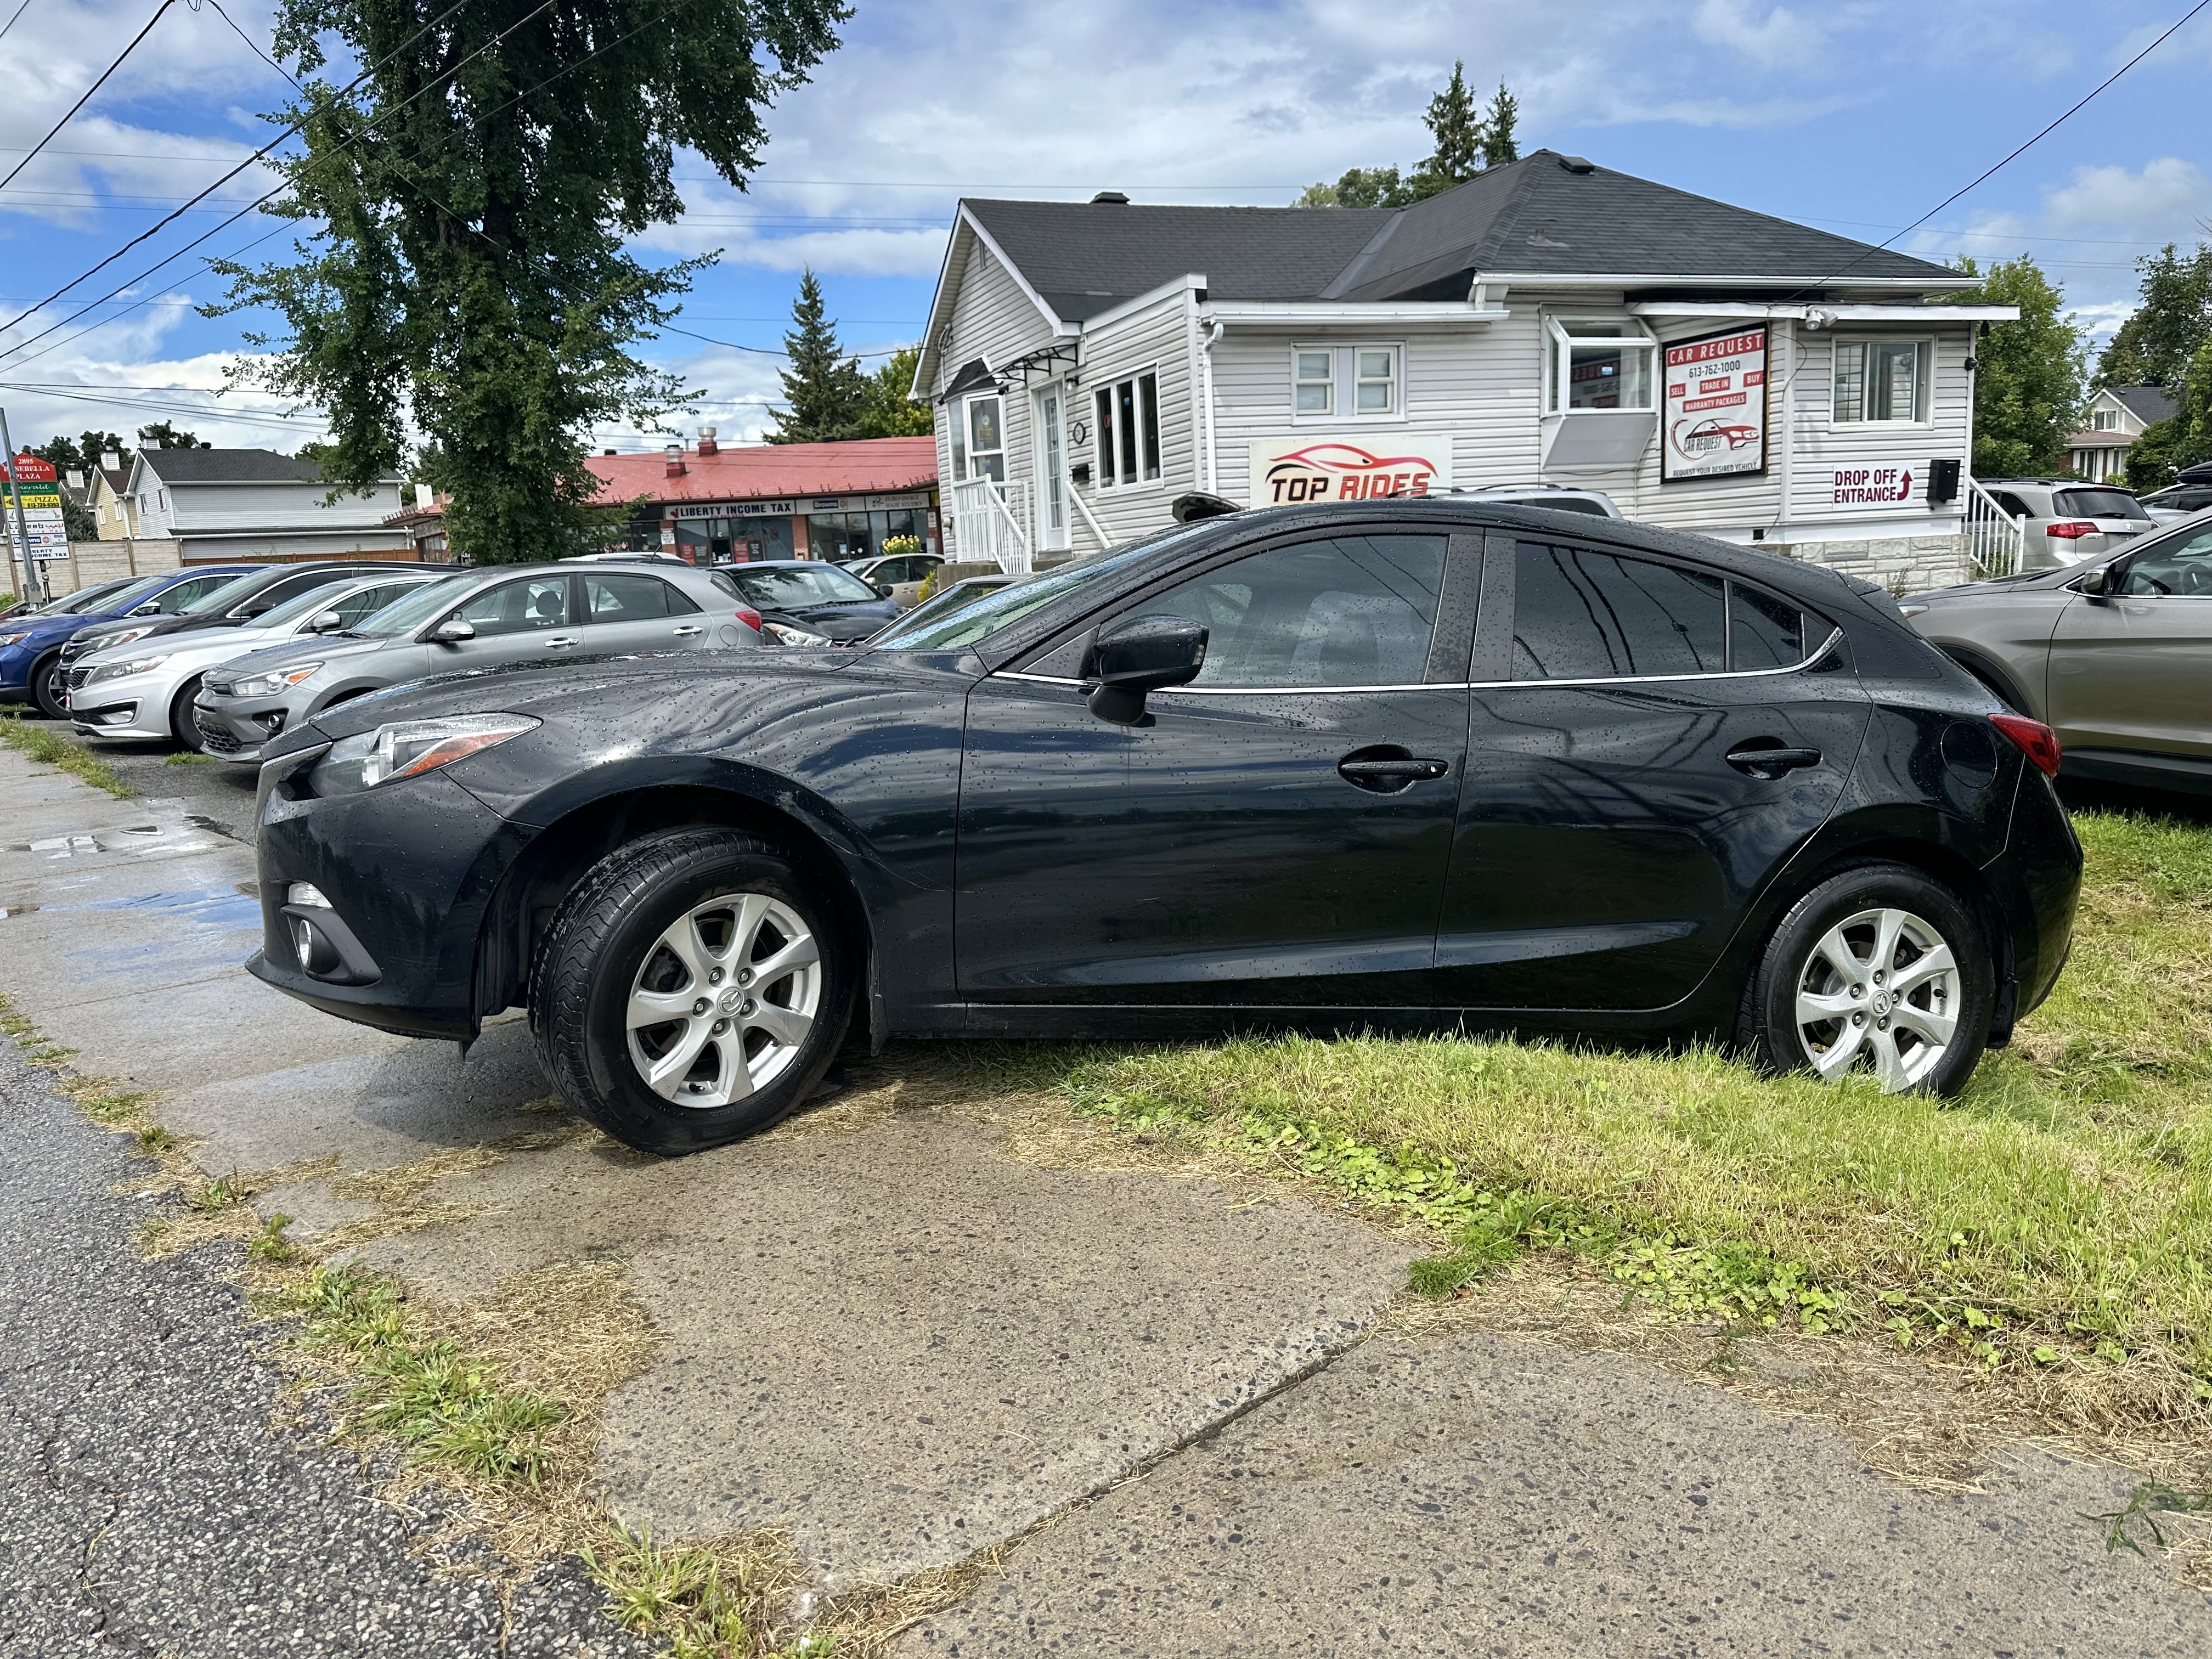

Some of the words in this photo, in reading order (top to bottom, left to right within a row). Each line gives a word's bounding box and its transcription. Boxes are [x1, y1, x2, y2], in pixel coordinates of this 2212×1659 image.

[1669, 348, 1693, 364] CAR
[1700, 334, 1762, 358] REQUEST
[1689, 360, 1740, 379] 613-762-1000
[1701, 380, 1720, 391] TRADE
[1722, 379, 1729, 387] IN
[1747, 374, 1760, 384] BUY
[1671, 386, 1684, 396] SELL
[1685, 400, 1714, 411] WARRANTY
[1716, 394, 1745, 407] PACKAGES
[1684, 439, 1695, 453] CAR
[1696, 436, 1722, 452] REQUEST
[1673, 468, 1695, 477] REQUEST
[1712, 465, 1734, 473] DESIRED
[1735, 462, 1757, 471] VEHICLE
[1835, 470, 1870, 486] DROP
[1874, 469, 1897, 485] OFF
[1271, 477, 1329, 503] TOP
[1339, 472, 1431, 500] RIDES
[1834, 487, 1897, 504] ENTRANCE
[680, 506, 721, 517] LIBERTY
[726, 504, 766, 514] INCOME
[771, 503, 791, 512] TAX
